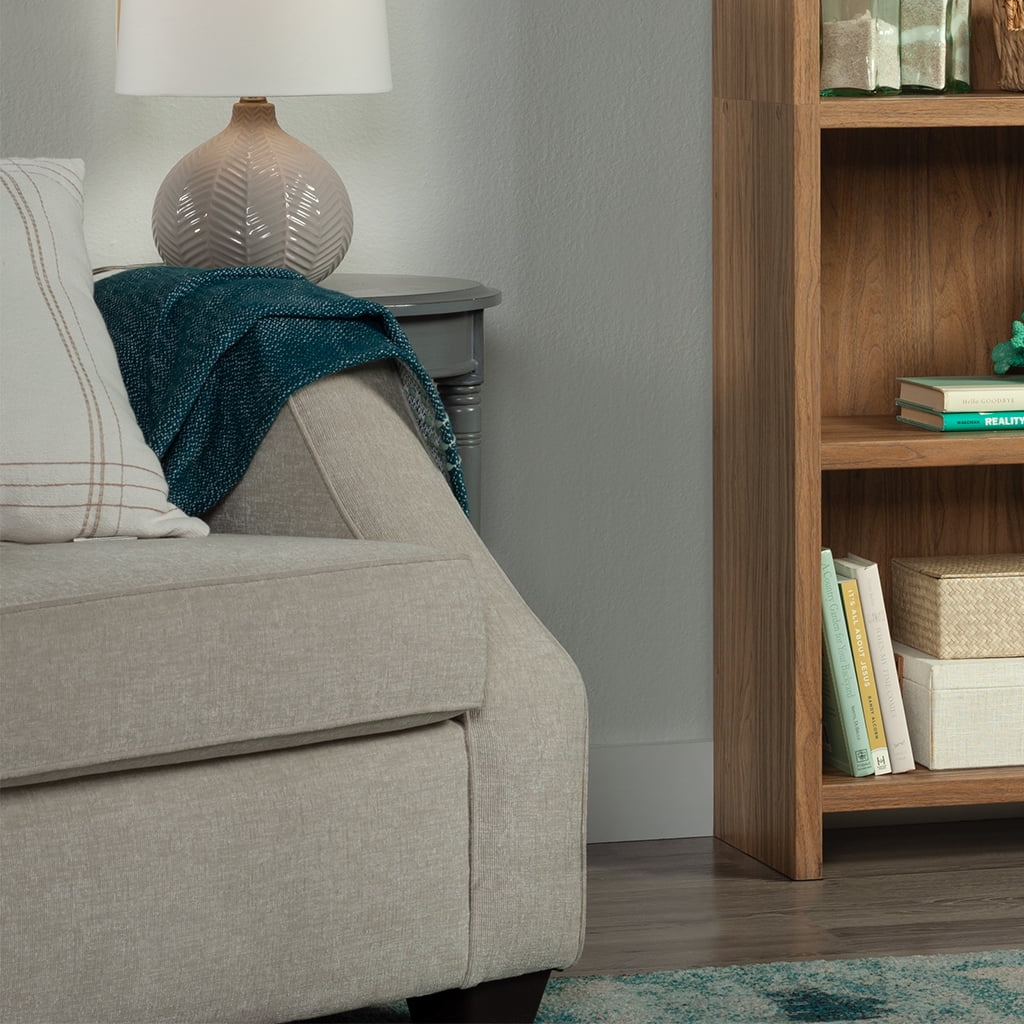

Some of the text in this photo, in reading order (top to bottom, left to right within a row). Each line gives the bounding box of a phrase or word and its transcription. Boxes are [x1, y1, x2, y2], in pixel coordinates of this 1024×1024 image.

[823, 570, 833, 602] Country
[830, 603, 840, 632] Garden
[836, 632, 844, 645] for
[848, 589, 871, 687] IT'S ALL ABOUT JESUS
[839, 644, 848, 664] Your
[842, 664, 854, 697] Backyard
[871, 717, 879, 739] ALCORN
